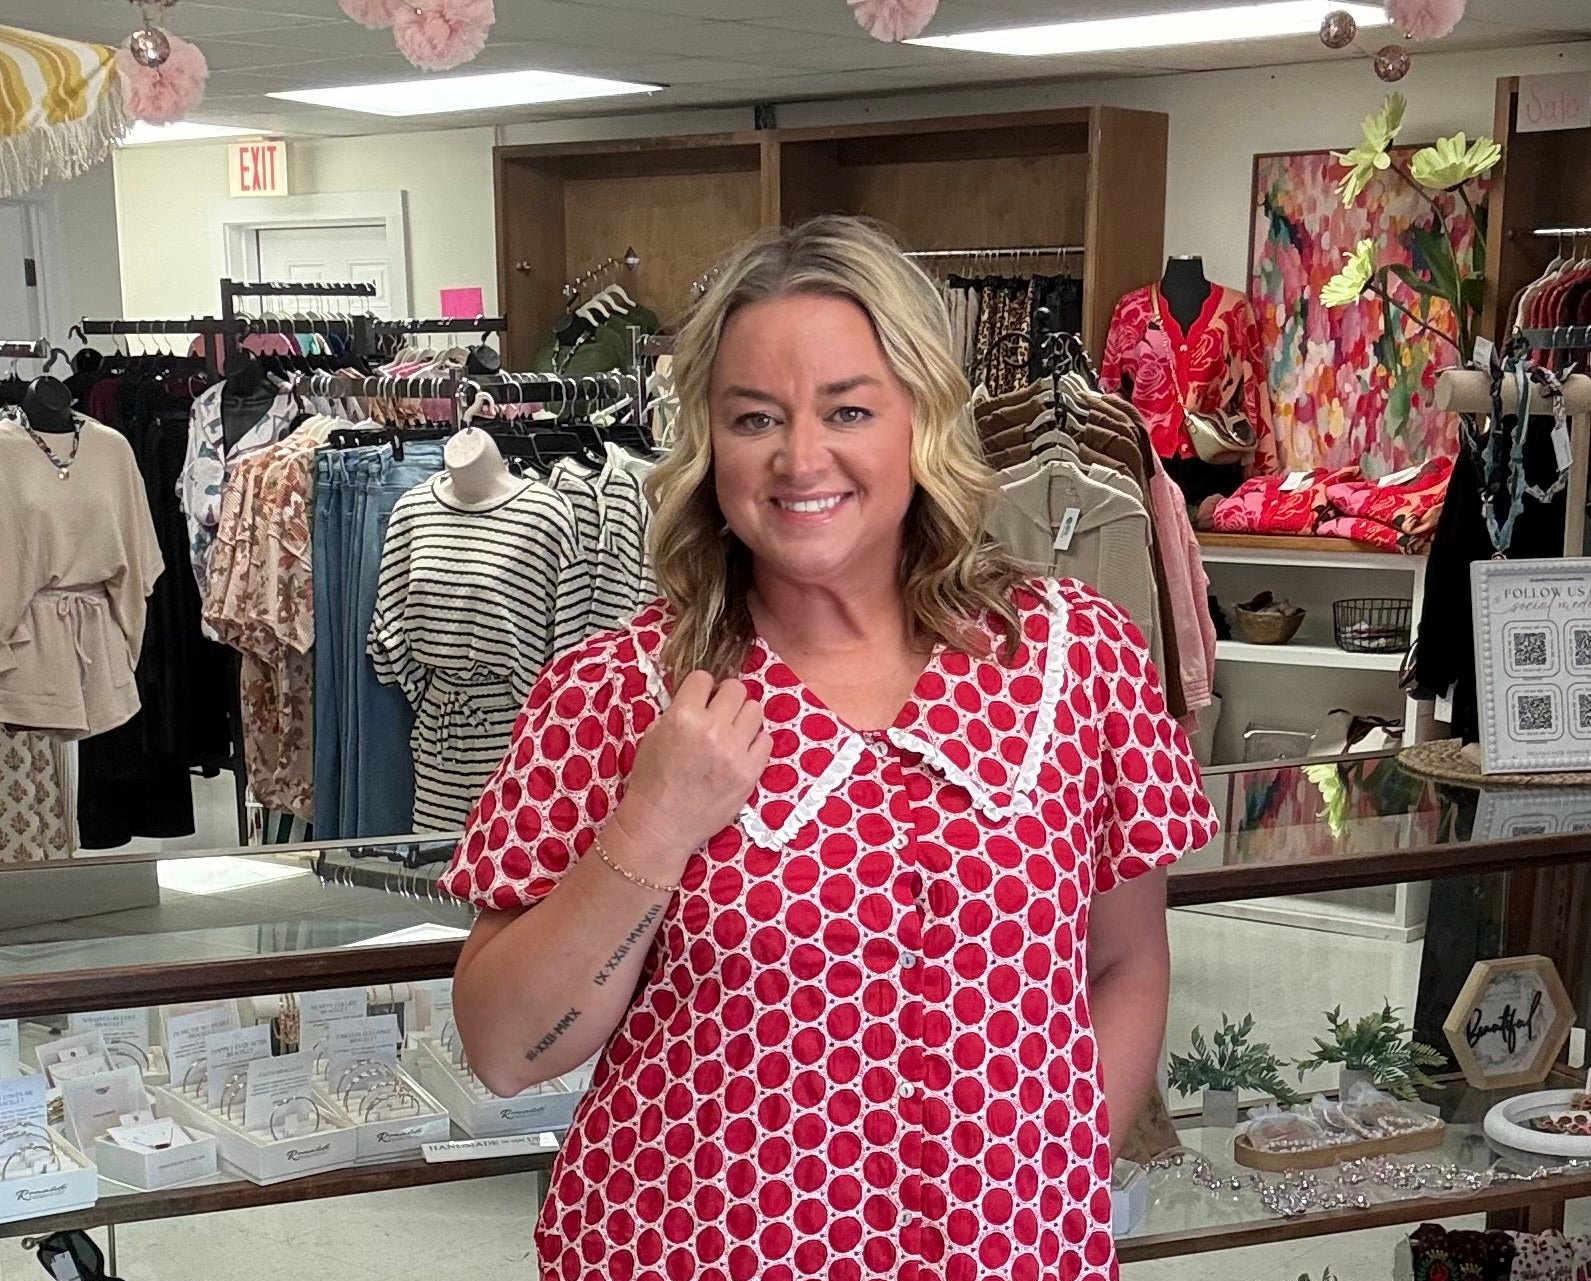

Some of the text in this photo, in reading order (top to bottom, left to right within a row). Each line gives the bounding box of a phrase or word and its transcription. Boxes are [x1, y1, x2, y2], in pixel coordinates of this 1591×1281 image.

[239, 145, 277, 191] EXIT
[1505, 586, 1560, 599] FOLLOW
[1568, 585, 1586, 598] US
